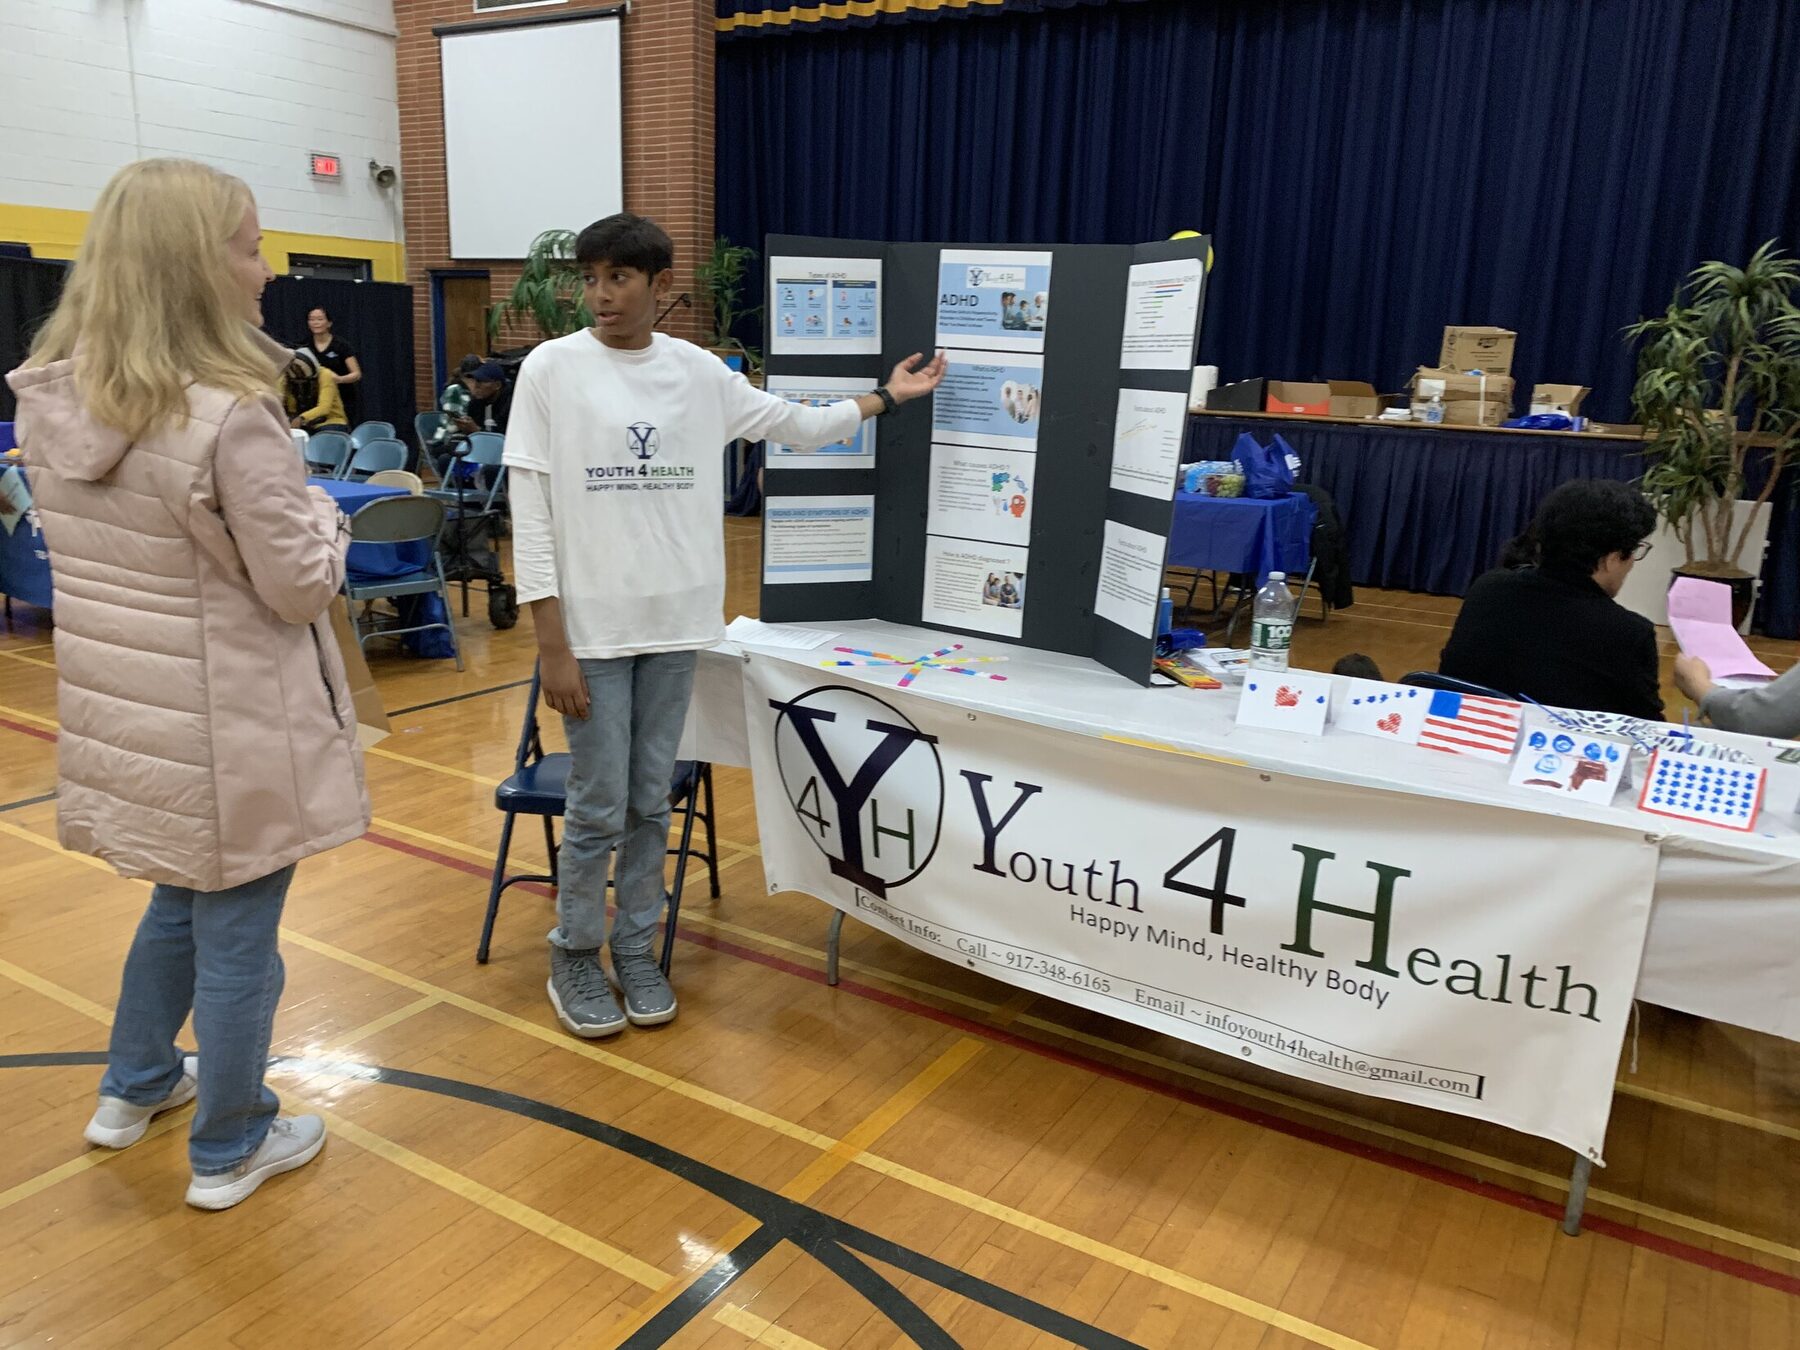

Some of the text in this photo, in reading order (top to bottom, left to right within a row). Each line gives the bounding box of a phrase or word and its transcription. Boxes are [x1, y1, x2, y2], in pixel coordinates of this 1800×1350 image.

[940, 293, 980, 307] ADHD
[585, 463, 694, 478] YOUTH 4 HEALTH
[586, 484, 614, 492] HAPPY
[643, 482, 674, 490] HEALTHY
[676, 482, 694, 490] BODY
[769, 698, 938, 900] Y
[796, 775, 915, 870] 4 H
[960, 768, 1602, 1022] Youth 4 Health
[861, 894, 905, 929] Contact
[908, 918, 941, 942] Info:
[956, 936, 987, 958] Call
[1005, 951, 1112, 993] 917-348-6165
[1134, 988, 1185, 1017] Email
[1204, 1009, 1471, 1095] infoyouth4health@gmail.com
[1070, 904, 1390, 1010] Happy Mind, Healthy Body
